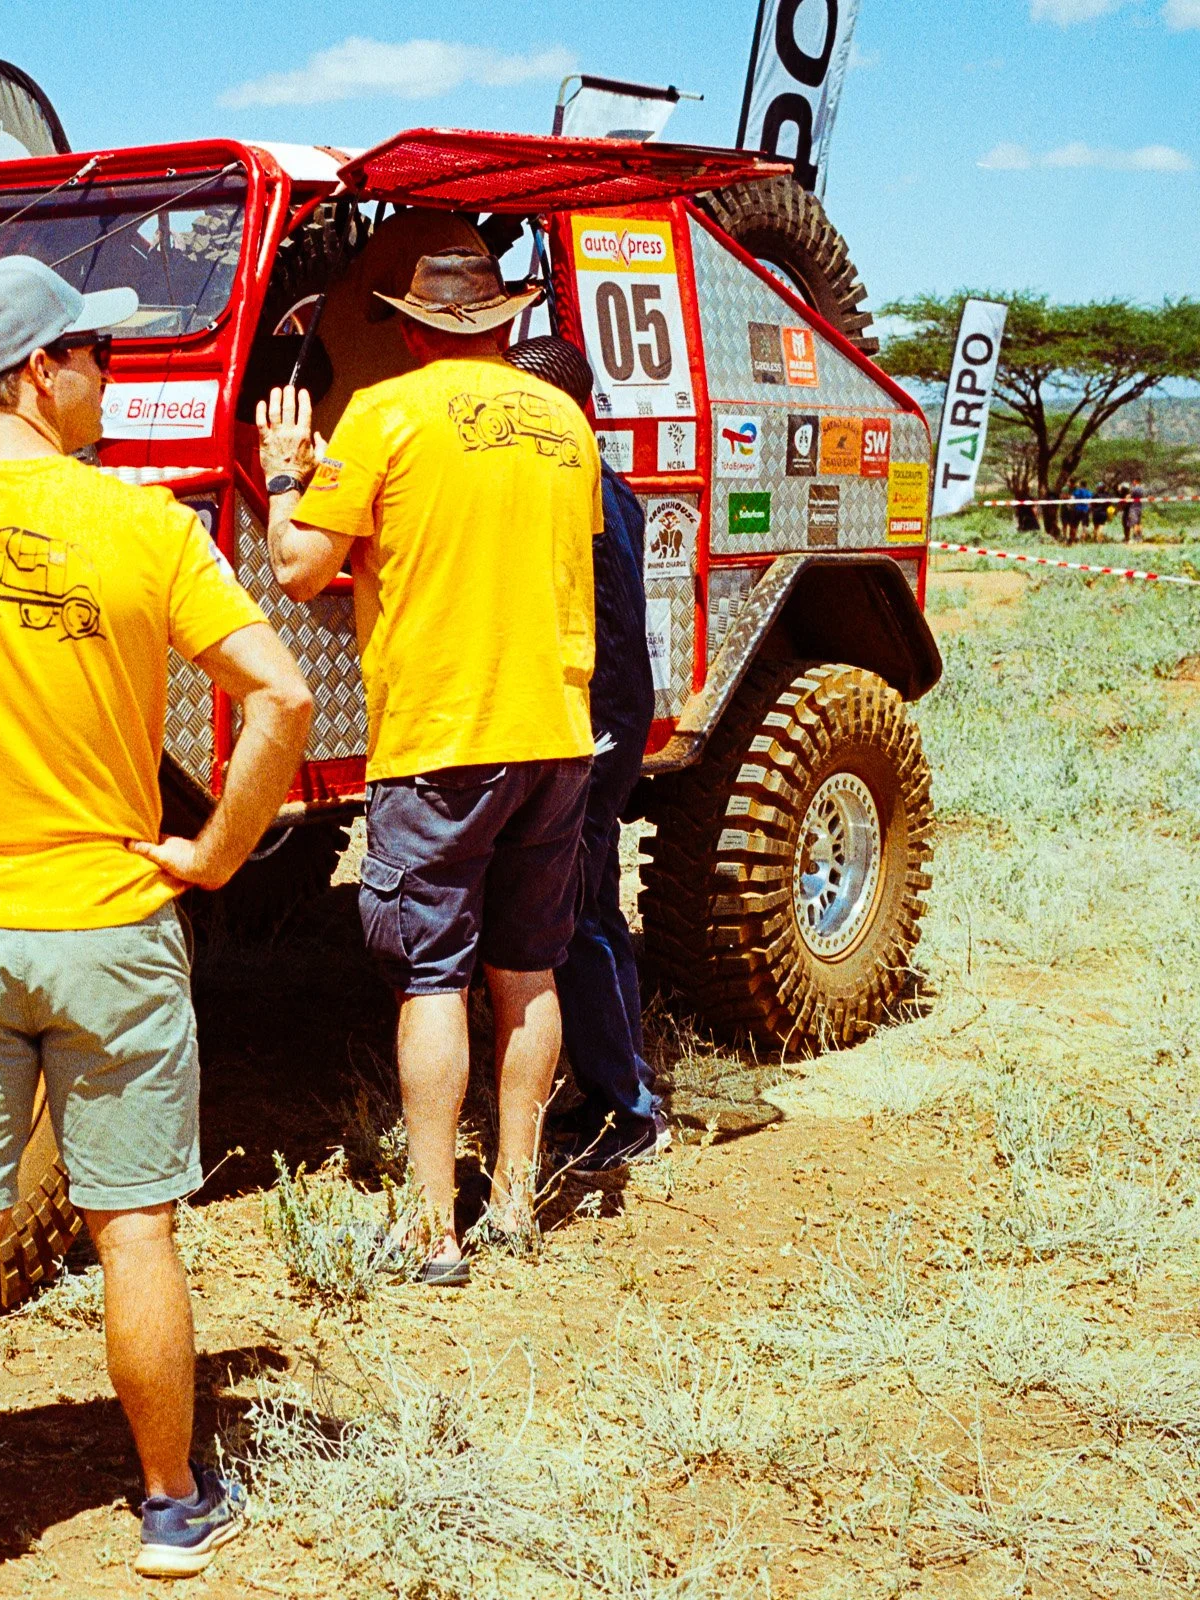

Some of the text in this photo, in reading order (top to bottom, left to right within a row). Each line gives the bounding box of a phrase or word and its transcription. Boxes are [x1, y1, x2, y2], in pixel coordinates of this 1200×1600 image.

[596, 281, 673, 382] 05
[127, 398, 206, 419] Bimeda
[942, 333, 993, 489] TARPO
[864, 430, 889, 455] SW
[666, 461, 686, 470] NCBA
